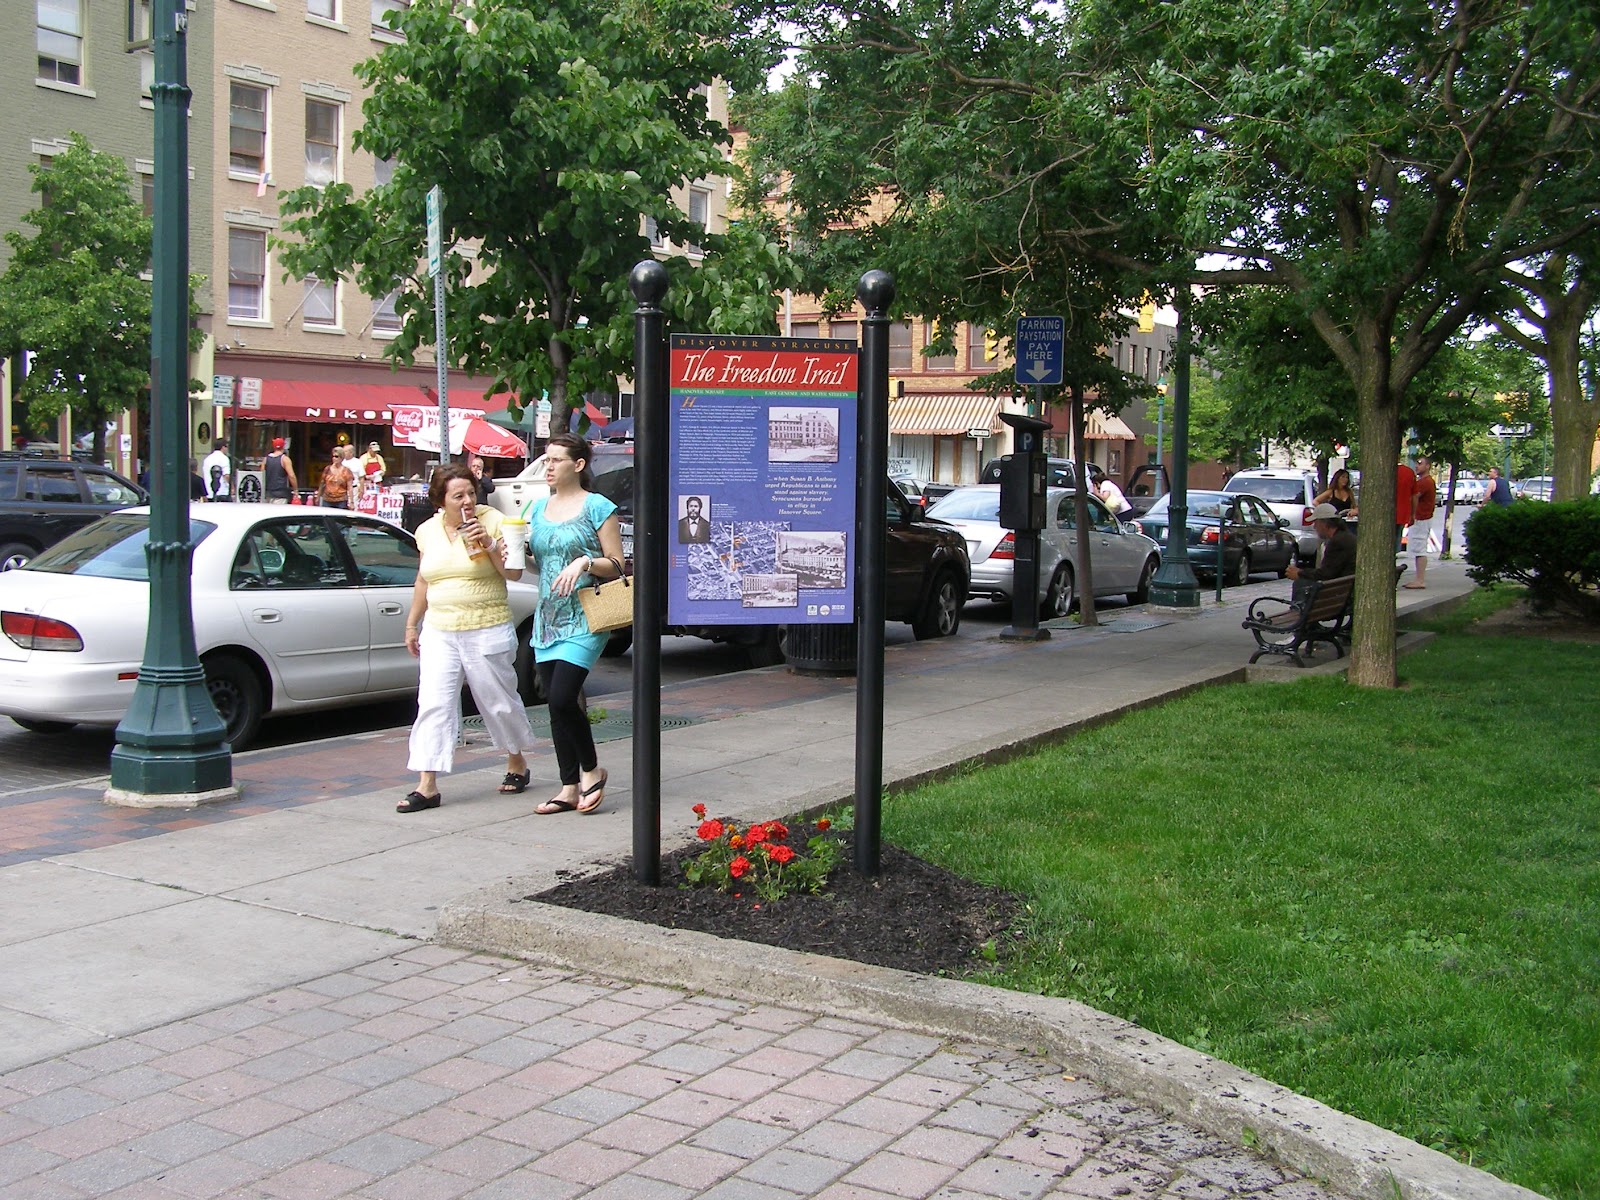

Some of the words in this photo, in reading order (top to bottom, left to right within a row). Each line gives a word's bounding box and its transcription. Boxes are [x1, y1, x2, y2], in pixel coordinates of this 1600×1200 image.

[1021, 320, 1060, 330] PARKING
[1019, 331, 1062, 341] PAYSTATION
[680, 339, 759, 348] DISCOVER
[771, 341, 850, 350] SYRACUSE
[1029, 342, 1051, 351] PAY
[1025, 351, 1053, 360] HERE
[681, 345, 716, 382] The
[717, 353, 797, 384] Freedom
[800, 355, 851, 385] Trail
[1024, 432, 1033, 450] P
[479, 444, 502, 454] Coca-Cola
[814, 475, 837, 483] Anthony
[383, 497, 403, 508] Pizz
